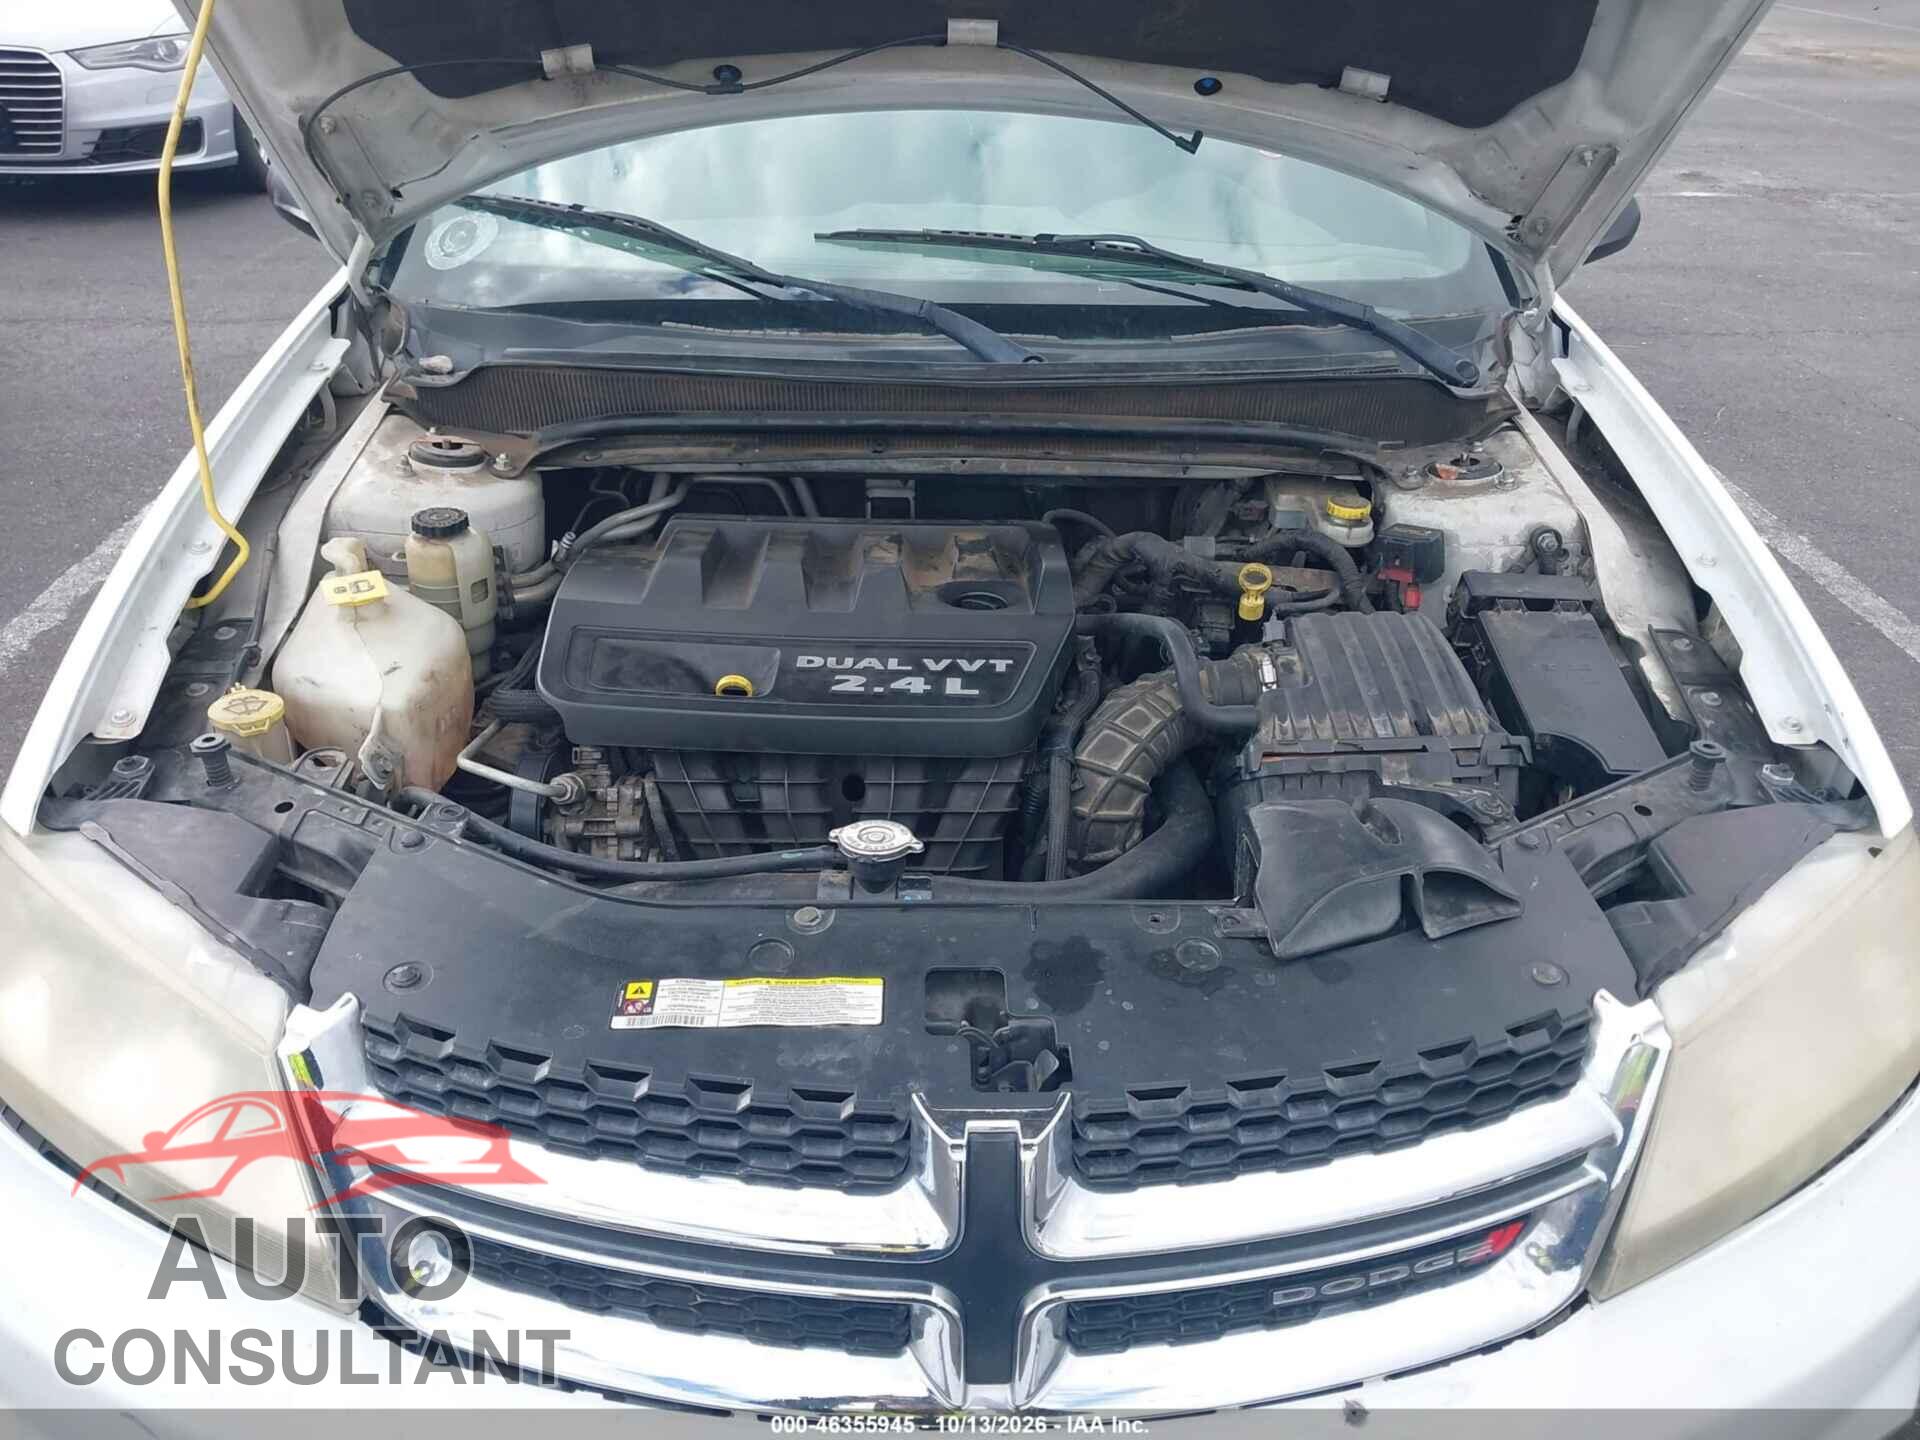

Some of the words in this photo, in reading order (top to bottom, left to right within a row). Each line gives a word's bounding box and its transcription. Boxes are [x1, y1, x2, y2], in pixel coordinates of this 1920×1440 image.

[796, 656, 913, 671] DUAL
[922, 658, 1014, 672] VVT
[1272, 1238, 1495, 1306] DODGE
